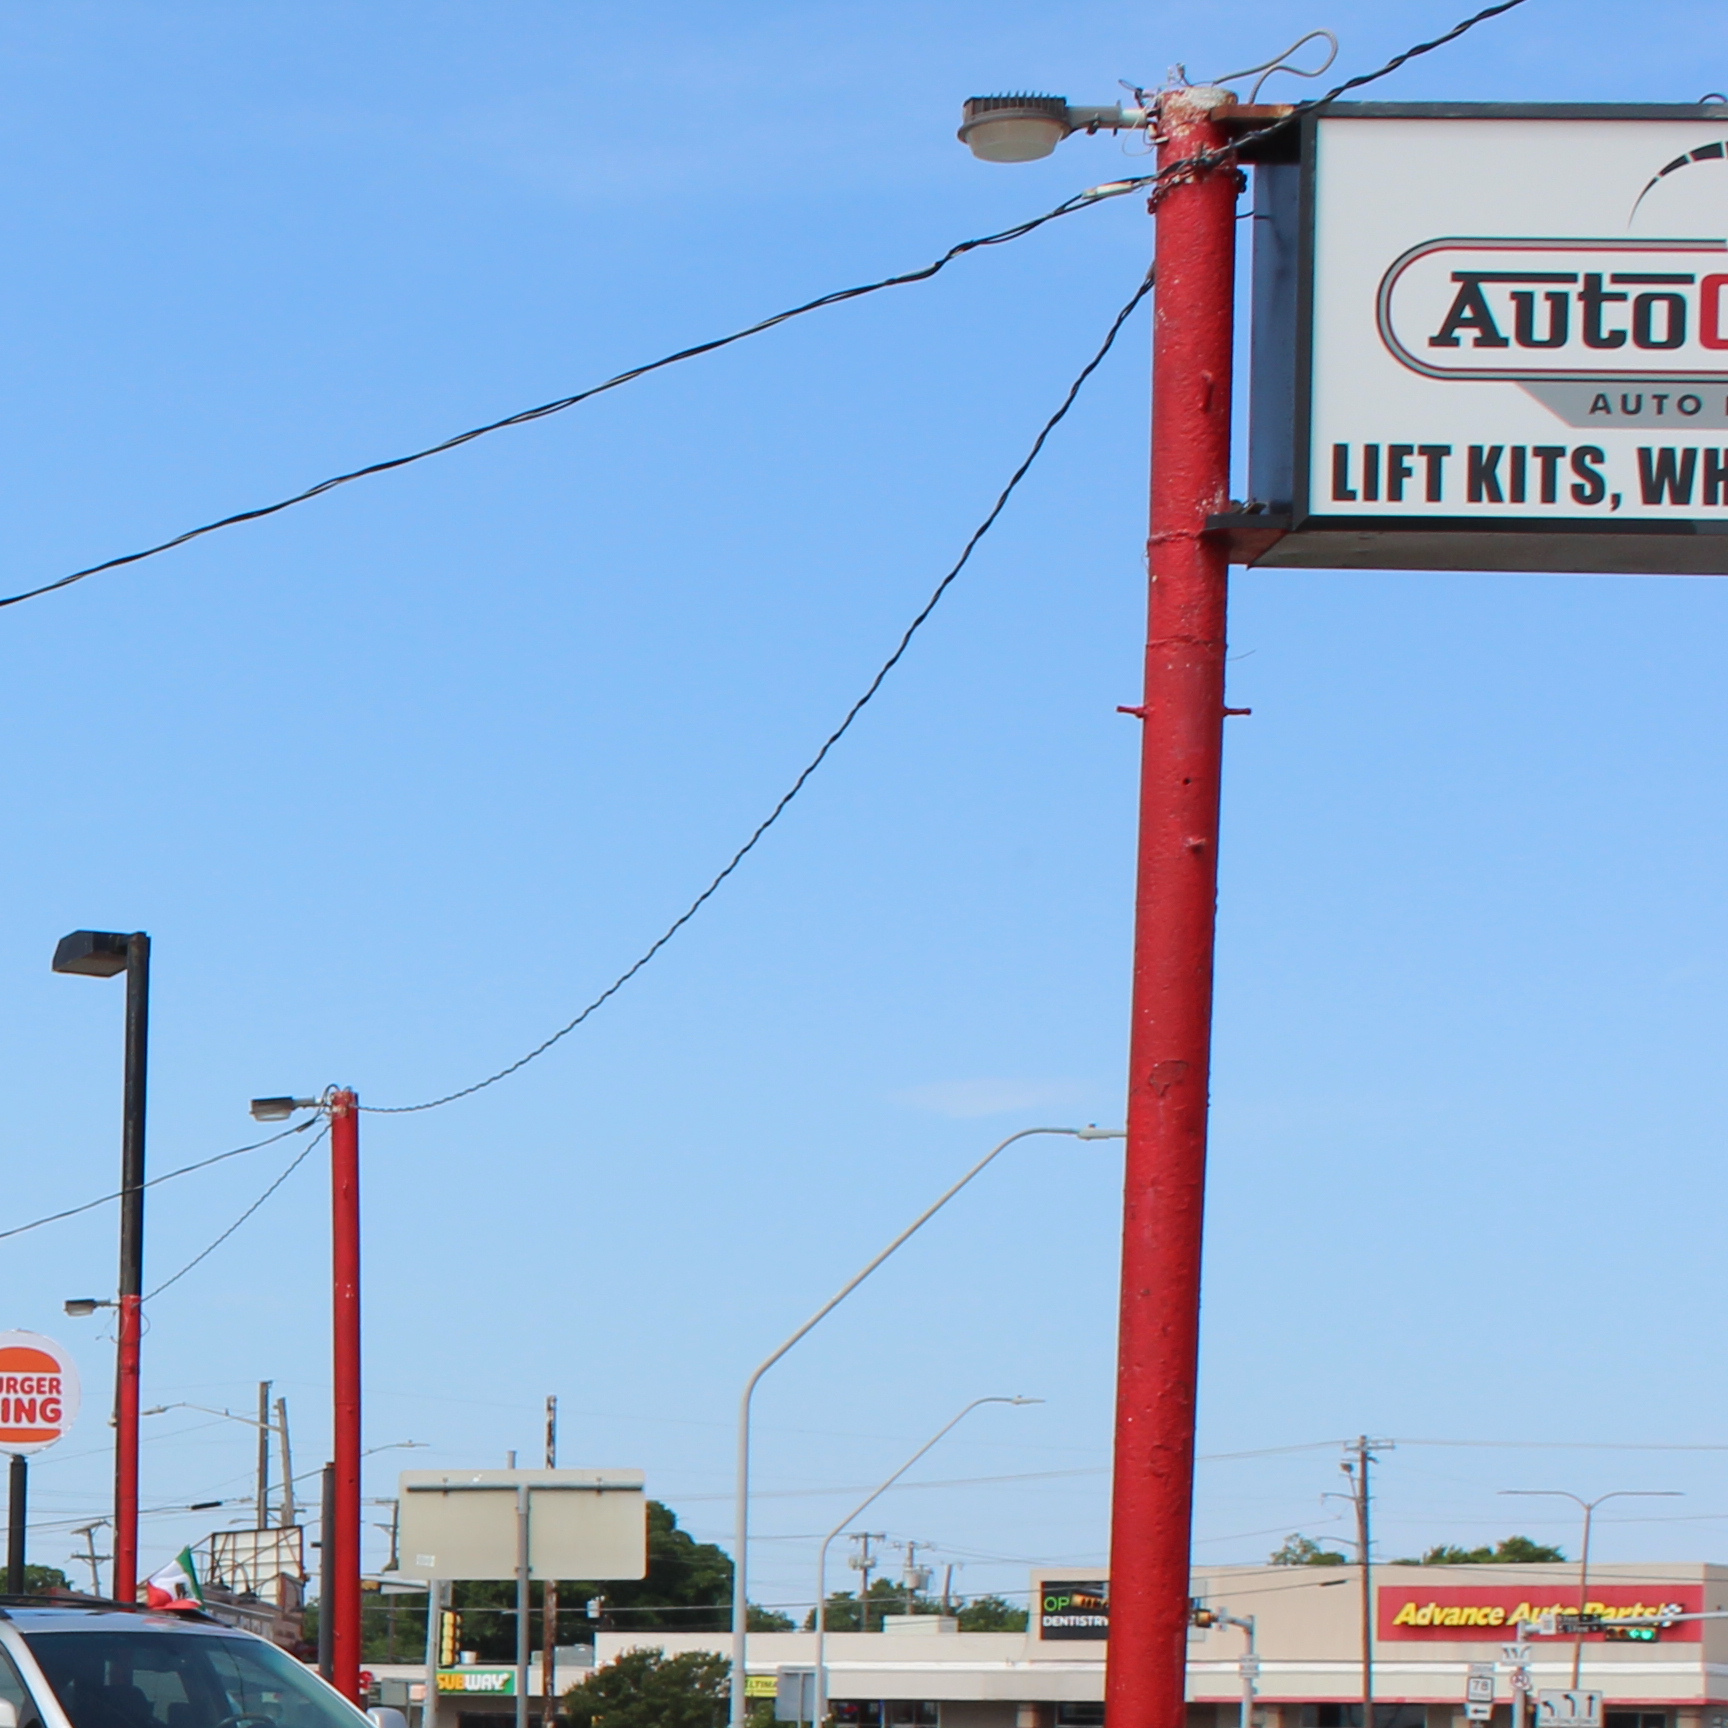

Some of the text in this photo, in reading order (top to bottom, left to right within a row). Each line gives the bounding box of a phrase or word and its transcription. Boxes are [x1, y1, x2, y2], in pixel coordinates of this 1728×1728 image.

[1588, 392, 1703, 417] AUTO
[1332, 443, 1453, 503] LIFT
[1467, 445, 1623, 512] KITS,
[1393, 1602, 1505, 1626] Advance
[436, 1672, 511, 1691] SUBWAY
[1472, 1679, 1490, 1692] 78
